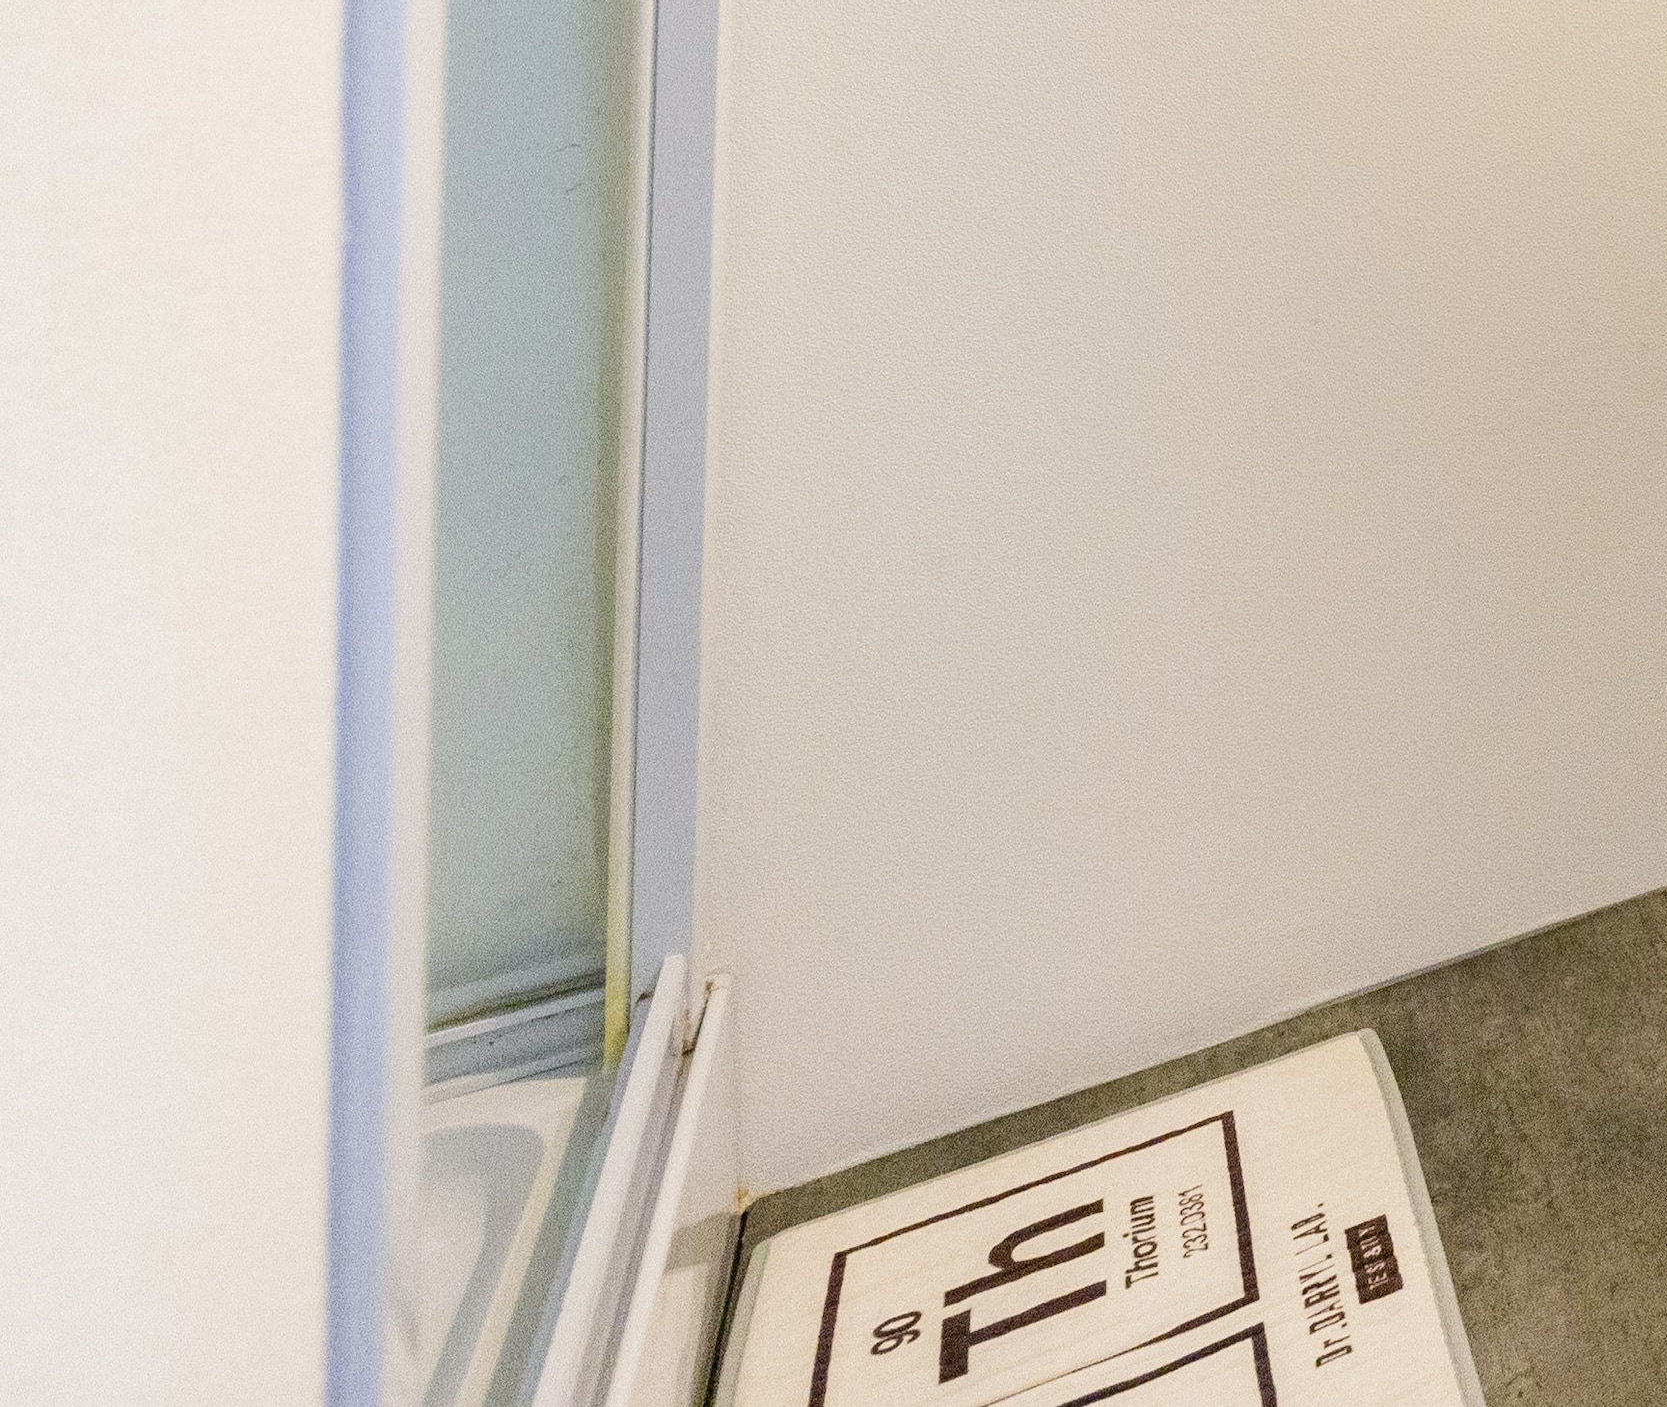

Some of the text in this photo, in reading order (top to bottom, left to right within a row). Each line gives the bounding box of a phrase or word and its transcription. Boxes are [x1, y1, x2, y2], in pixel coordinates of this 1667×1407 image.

[1124, 1194, 1159, 1290] Thorium
[871, 1310, 922, 1357] 90
[939, 1198, 1107, 1384] Th
